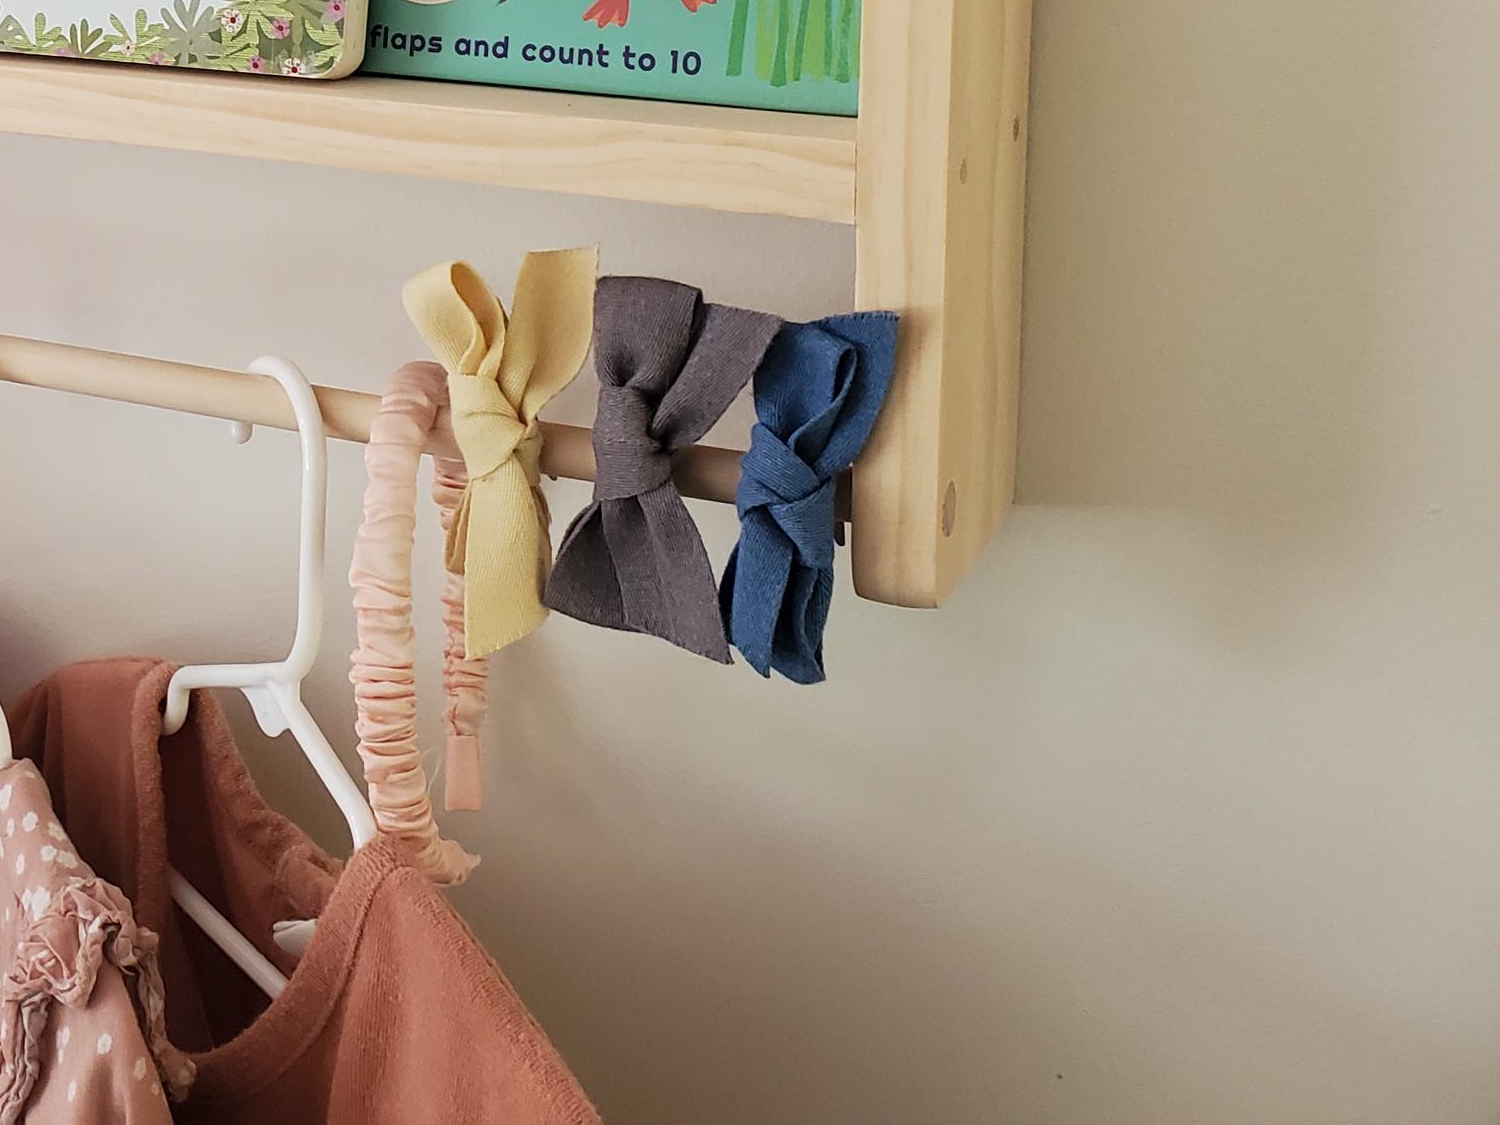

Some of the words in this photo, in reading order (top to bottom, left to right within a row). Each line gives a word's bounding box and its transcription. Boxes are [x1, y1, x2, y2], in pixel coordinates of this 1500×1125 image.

[371, 25, 443, 57] flaps
[454, 35, 510, 60] and
[521, 43, 610, 68] count
[622, 45, 656, 72] to
[670, 49, 702, 76] 10
